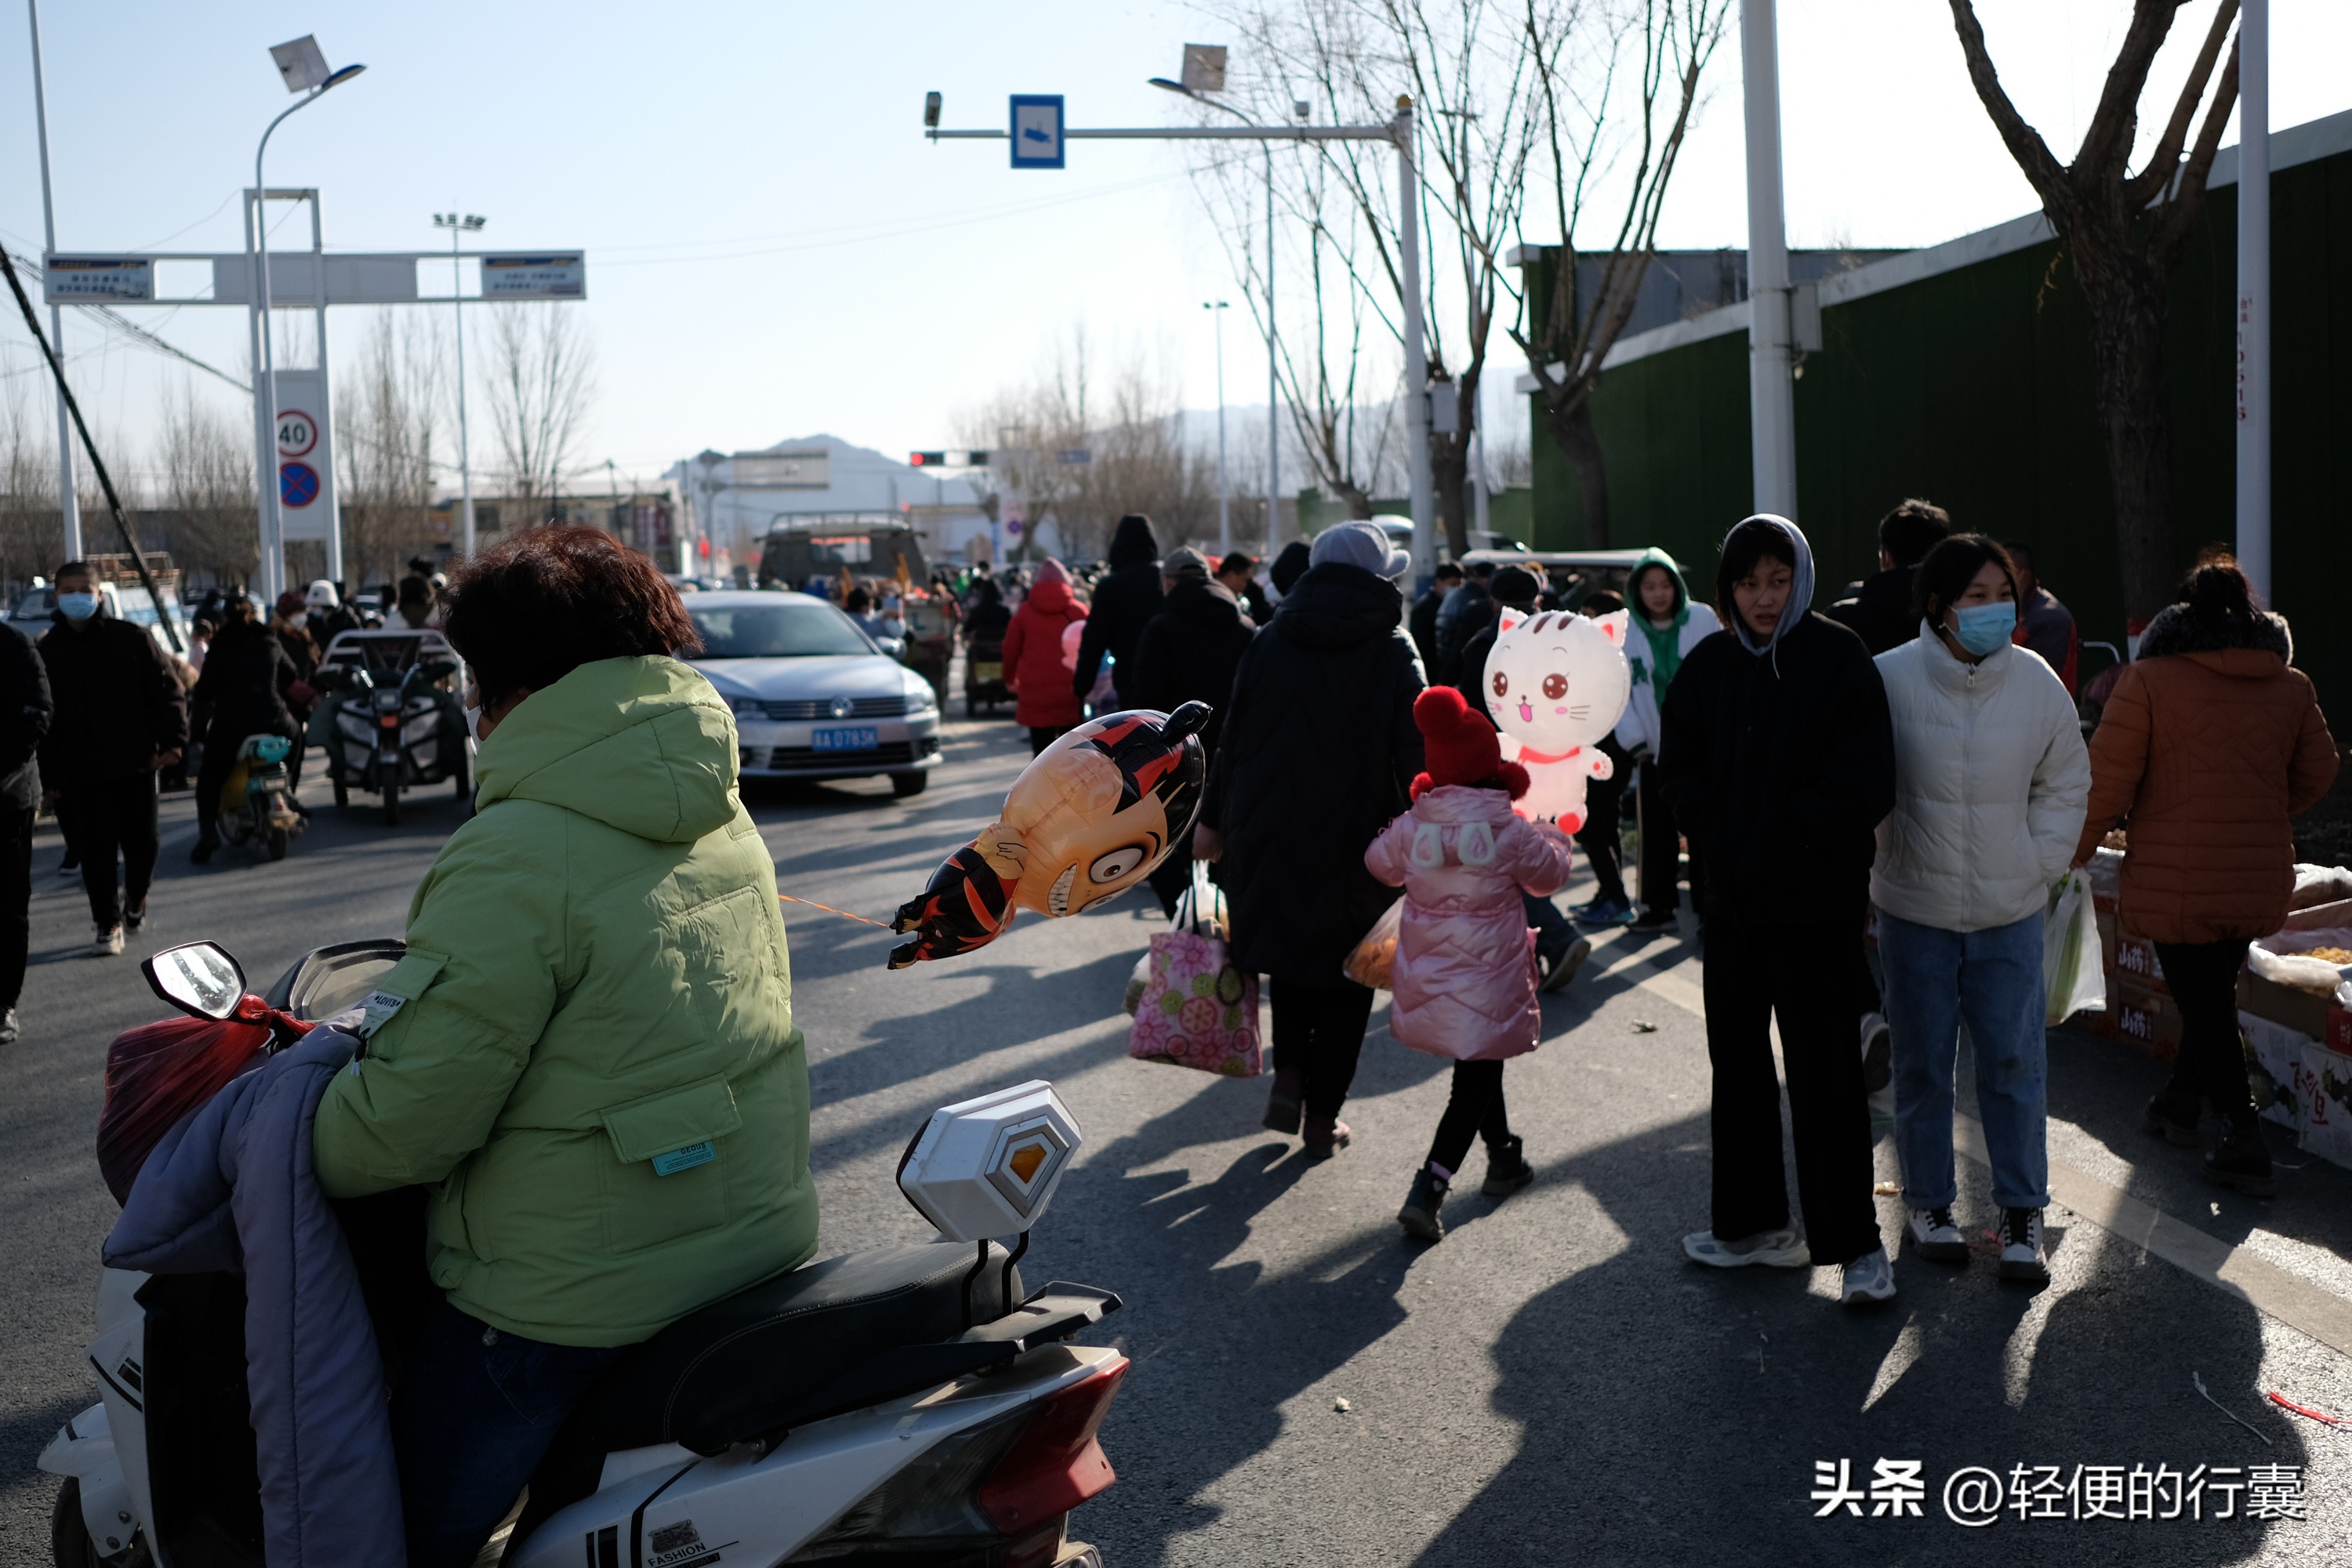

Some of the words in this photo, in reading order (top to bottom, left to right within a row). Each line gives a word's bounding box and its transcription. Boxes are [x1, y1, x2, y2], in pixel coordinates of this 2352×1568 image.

[278, 423, 307, 445] 40
[2118, 941, 2144, 975] 山药
[2121, 1006, 2147, 1040] 山药
[648, 1542, 706, 1567] FASHION
